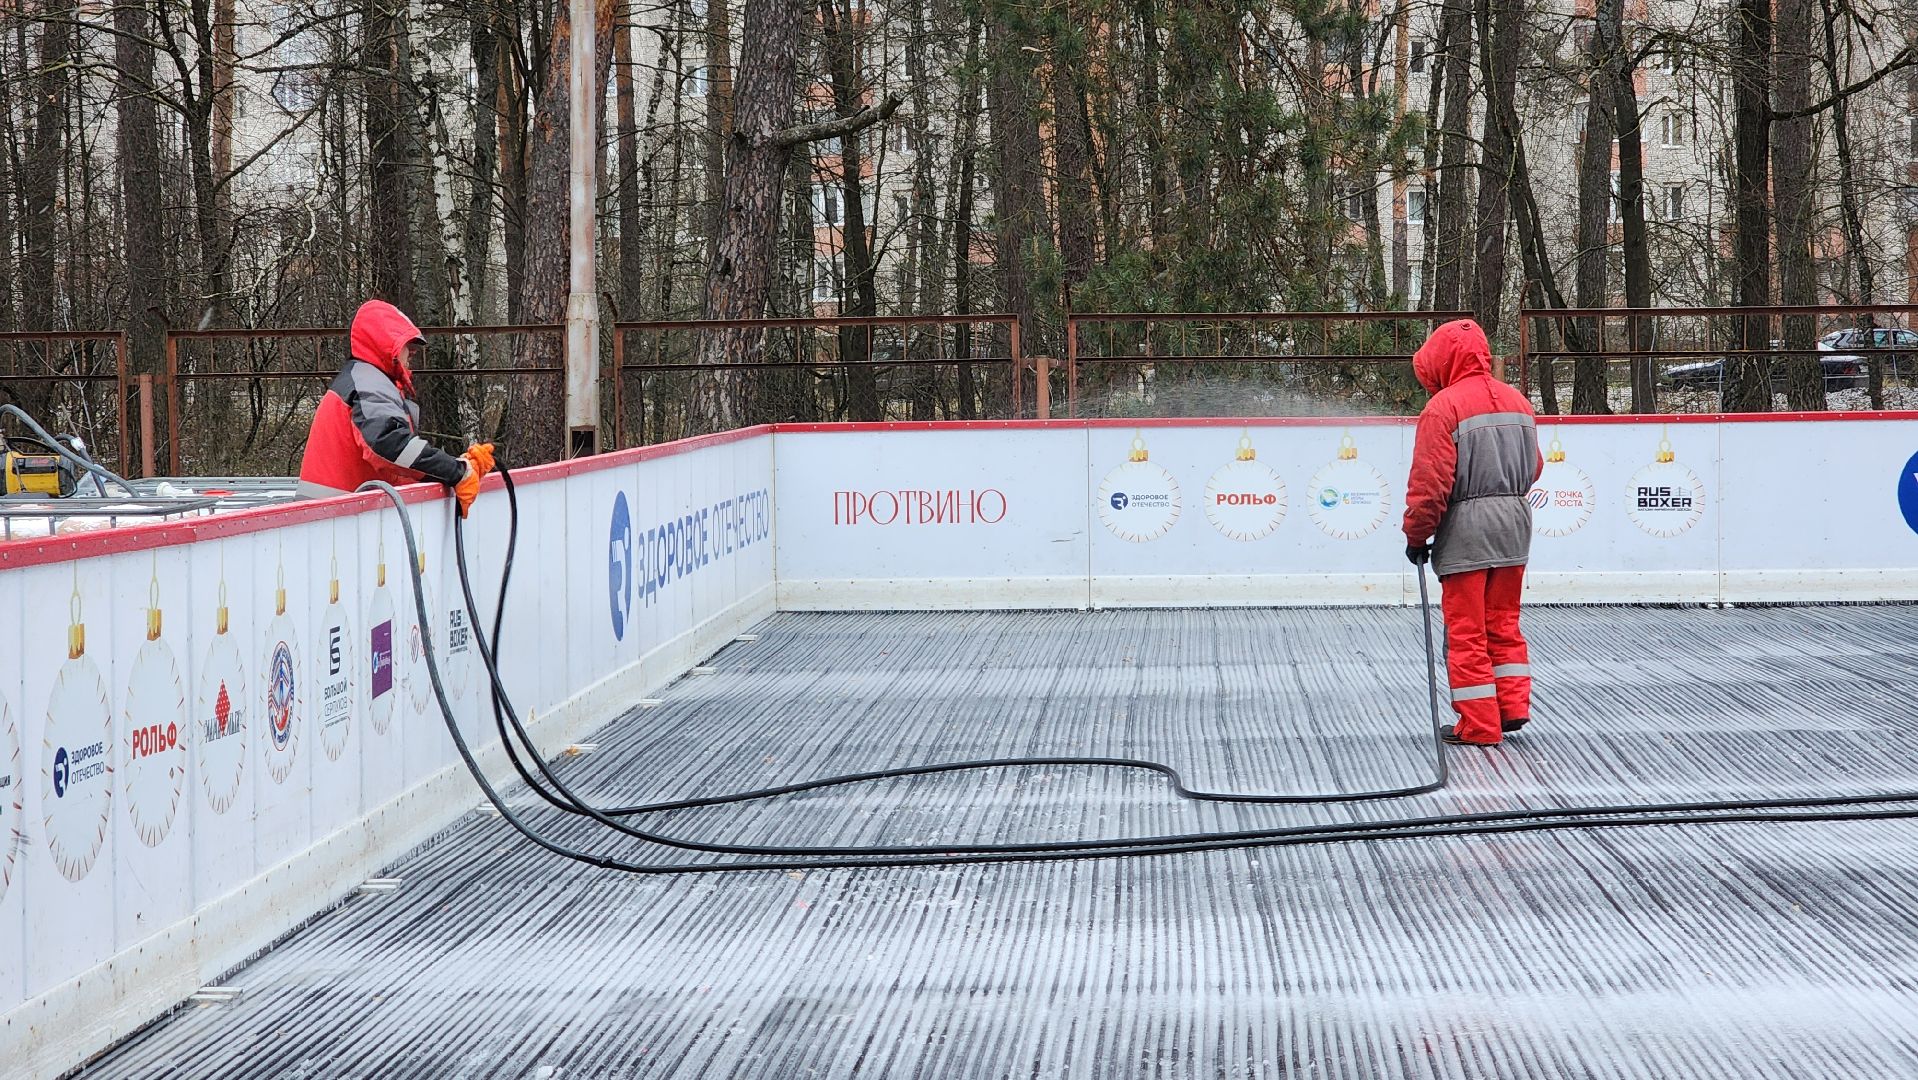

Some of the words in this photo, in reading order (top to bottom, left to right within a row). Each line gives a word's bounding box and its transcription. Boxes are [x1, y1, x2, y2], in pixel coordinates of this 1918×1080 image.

[1216, 493, 1277, 505] РОЛЬФ
[1554, 490, 1583, 499] ТОЧКА
[1637, 487, 1671, 497] RUS
[834, 489, 1007, 525] ПРОТВИНО
[1554, 499, 1583, 507] РОСТА
[1637, 497, 1692, 508] BOXER
[637, 507, 709, 608] ЗДОРОВОЕ
[712, 487, 769, 561] ОТЕЧЕСТВО
[132, 720, 178, 760] РОЛЬФ
[71, 741, 103, 766] ЗДОРОВОЕ
[71, 761, 105, 785] ОТЕЧЕСТВО
